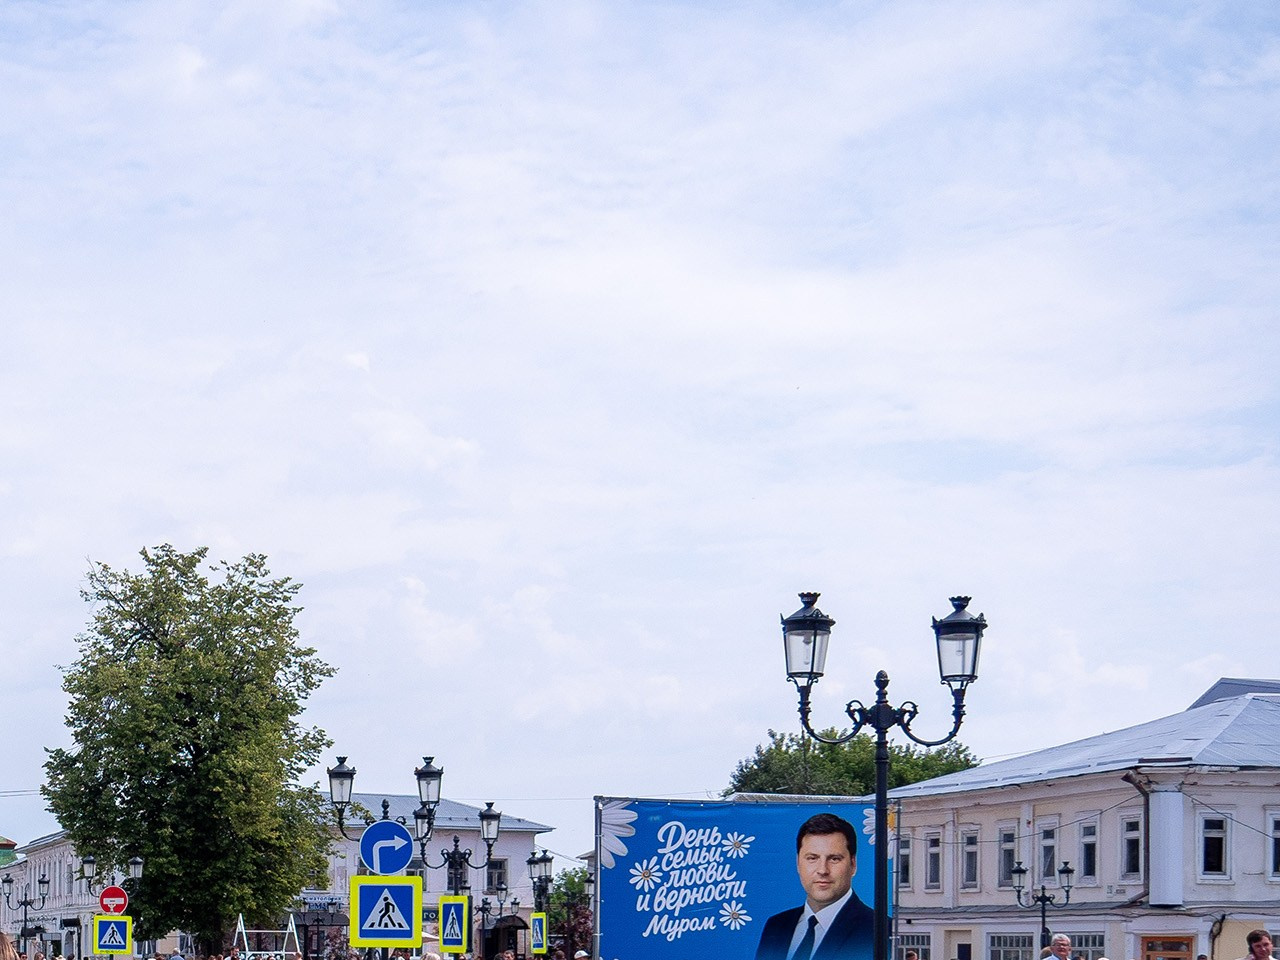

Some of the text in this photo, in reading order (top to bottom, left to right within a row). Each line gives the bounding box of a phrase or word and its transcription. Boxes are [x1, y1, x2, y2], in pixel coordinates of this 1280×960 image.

[657, 820, 722, 853] День
[661, 846, 724, 871] семьи,
[663, 861, 737, 888] любви
[636, 880, 747, 916] и верности
[642, 914, 716, 941] Муром
